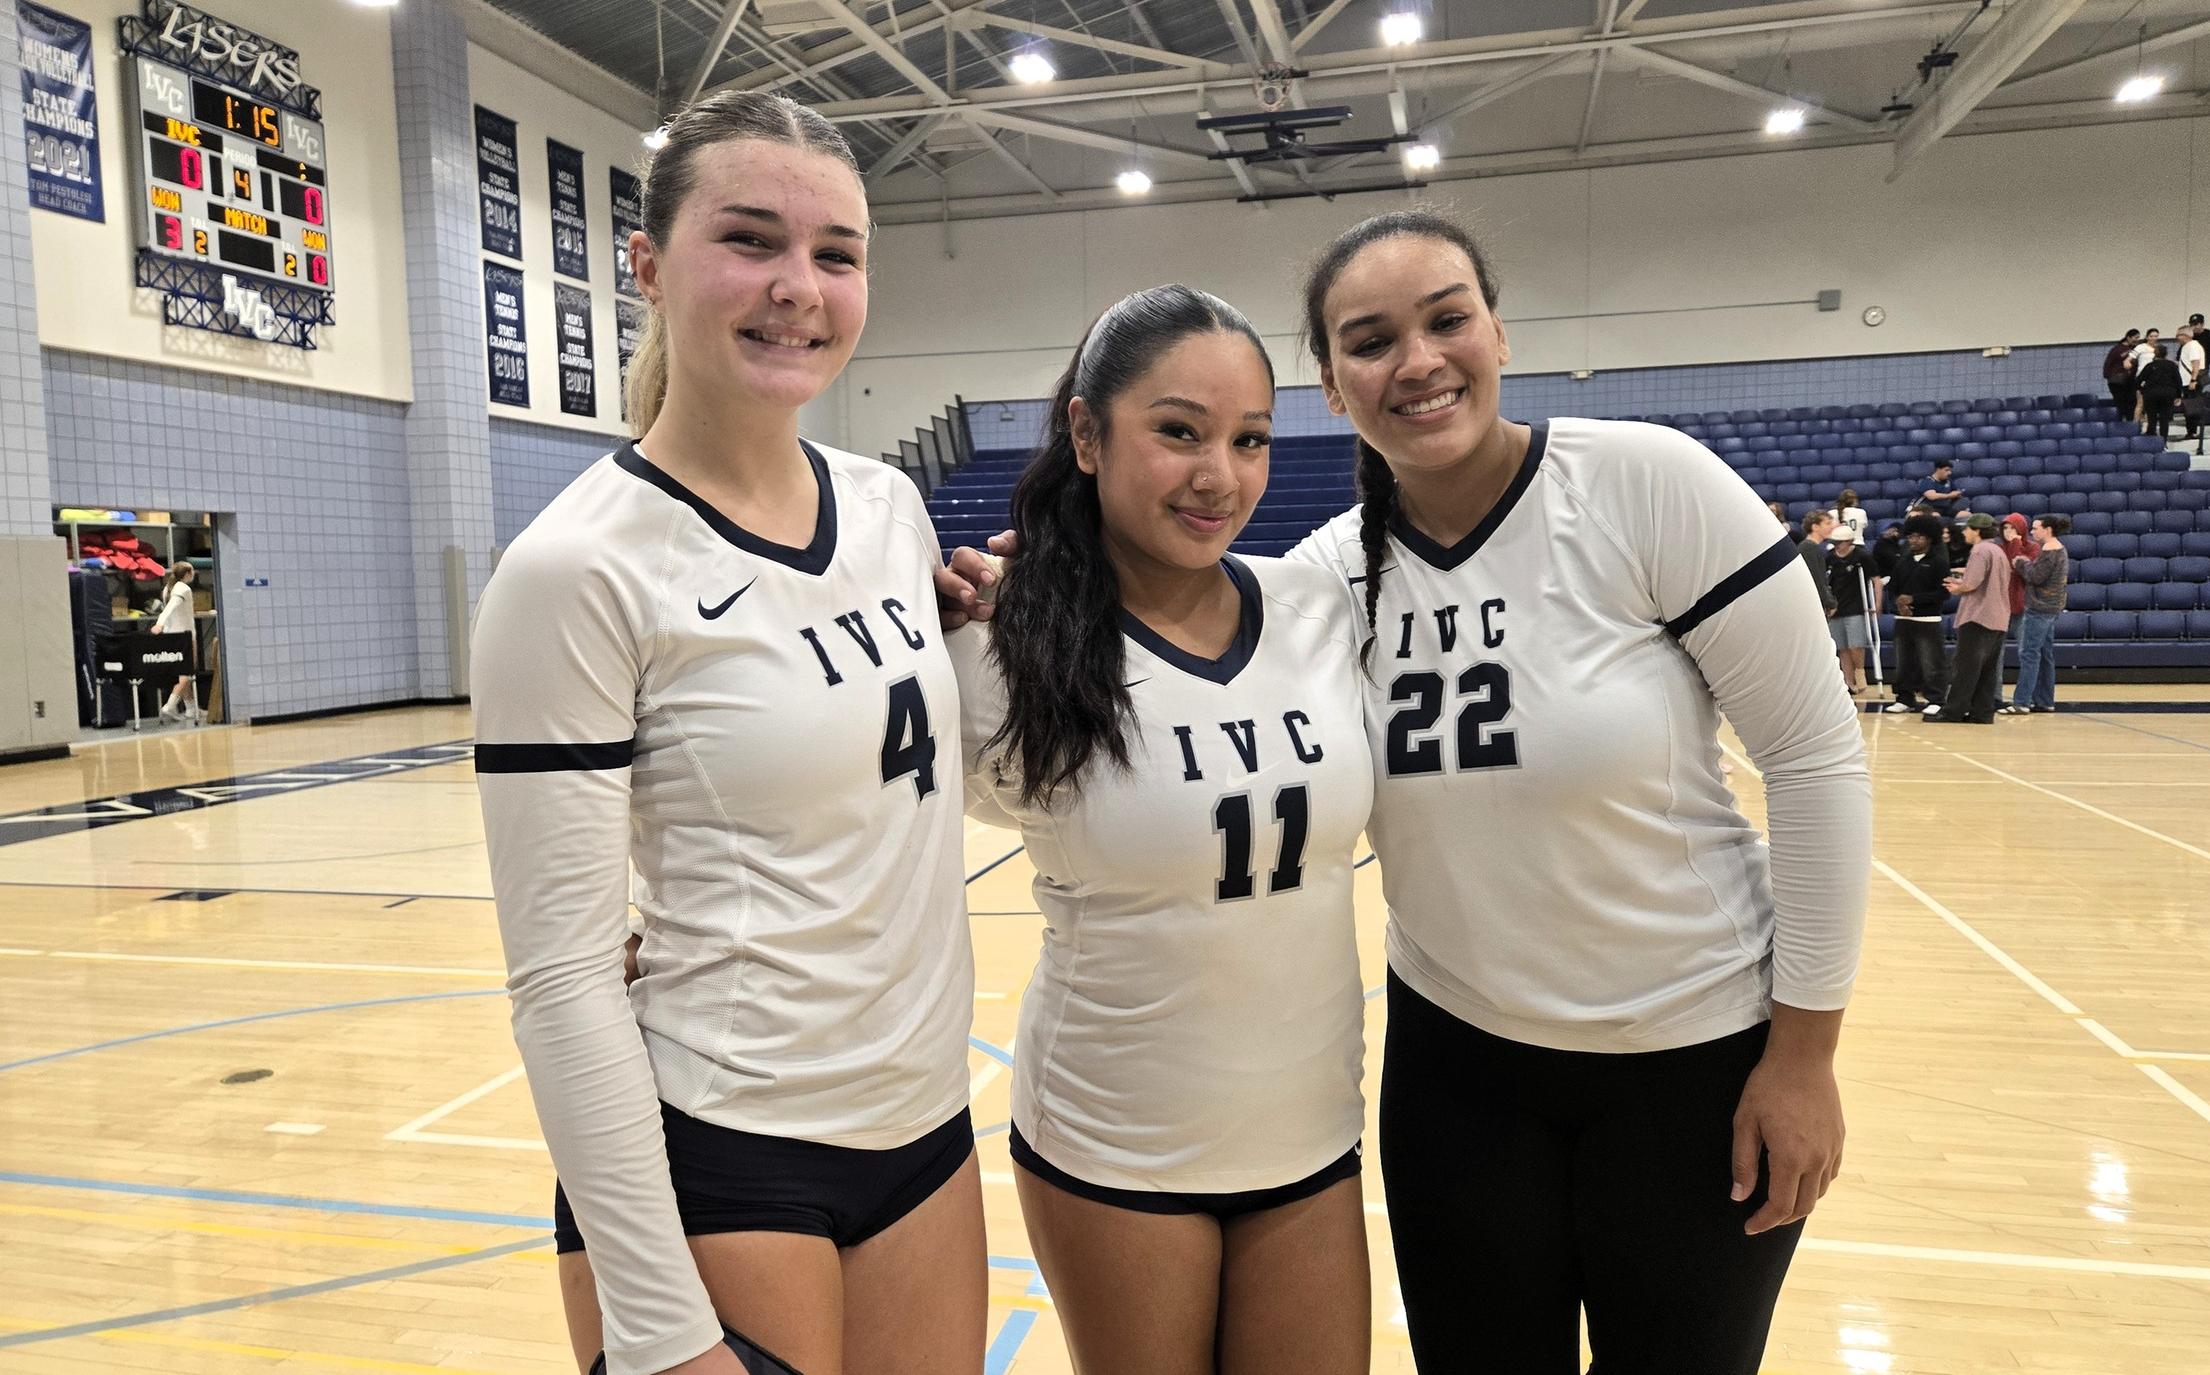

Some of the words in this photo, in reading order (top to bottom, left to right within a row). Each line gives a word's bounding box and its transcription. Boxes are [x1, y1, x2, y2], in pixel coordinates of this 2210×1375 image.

[33, 88, 77, 116] STATE
[143, 61, 183, 113] IVC
[166, 117, 201, 146] IVC
[286, 115, 320, 160] IVC
[26, 129, 93, 185] 2021
[179, 146, 203, 190] 0
[223, 147, 257, 168] PERIOD
[234, 169, 250, 198] 4
[480, 181, 519, 206] CHAMPIONS
[224, 206, 268, 236] MATCH
[304, 186, 324, 226] 0
[484, 198, 518, 234] 2014
[163, 215, 182, 250] 3
[195, 230, 207, 254] 2
[284, 254, 296, 277] 2
[312, 255, 328, 285] 0
[222, 273, 275, 341] IVC
[488, 334, 527, 354] CHAMPIONS
[493, 352, 525, 381] 2016
[798, 597, 926, 688] IVC
[1395, 598, 1506, 659] IVC
[142, 651, 183, 664] molten
[1385, 659, 1523, 779] 22
[878, 669, 941, 808] 4
[1172, 709, 1324, 784] IVC
[1210, 780, 1313, 904] 11
